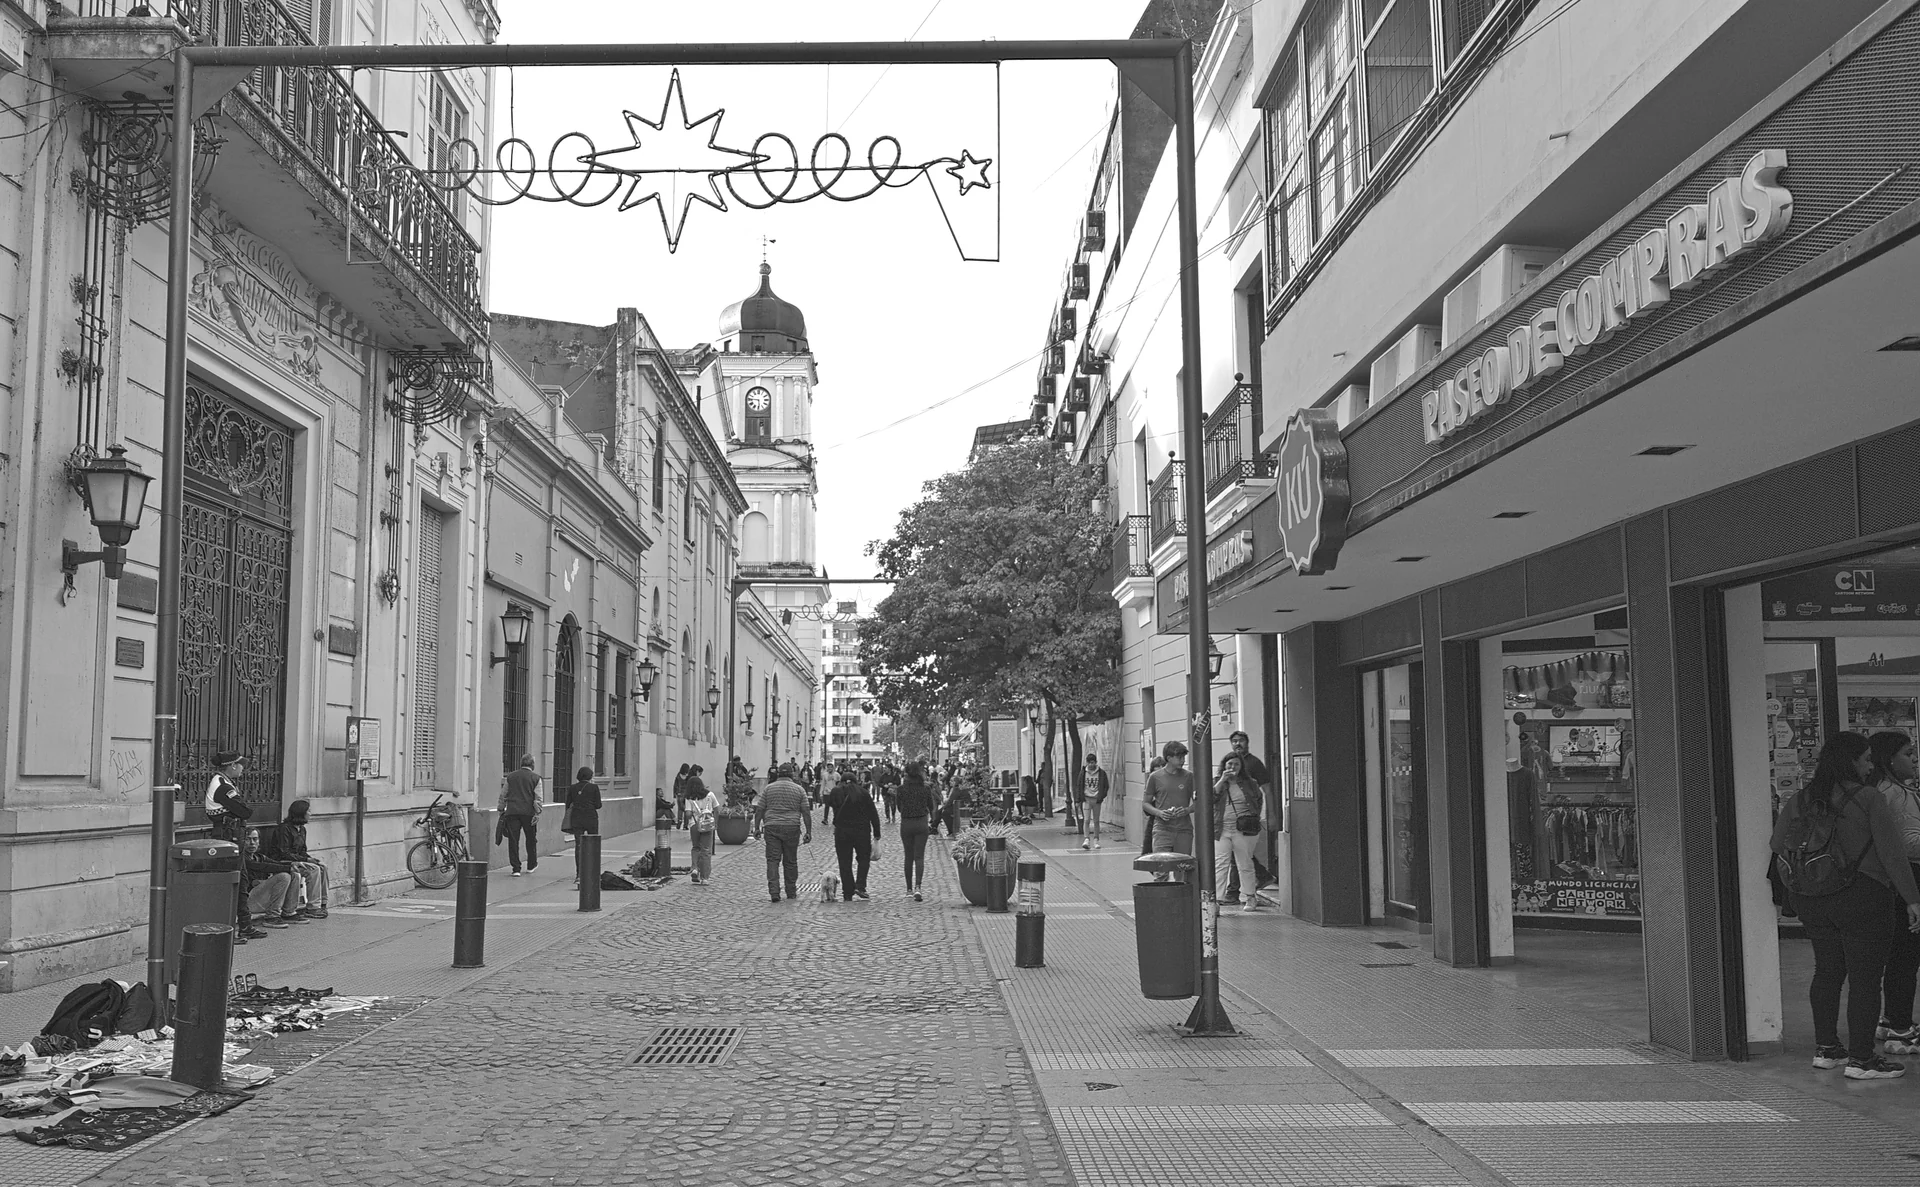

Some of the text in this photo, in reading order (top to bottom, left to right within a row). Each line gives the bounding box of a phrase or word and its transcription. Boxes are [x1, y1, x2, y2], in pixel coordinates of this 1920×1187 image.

[1421, 149, 1794, 445] PASEO DE COMPRAS
[1285, 443, 1312, 530] KÚ
[1834, 569, 1876, 592] CN
[1584, 881, 1637, 889] LICENCIAS
[1557, 889, 1625, 900] CARTOON
[1556, 898, 1626, 909] NETWORK
